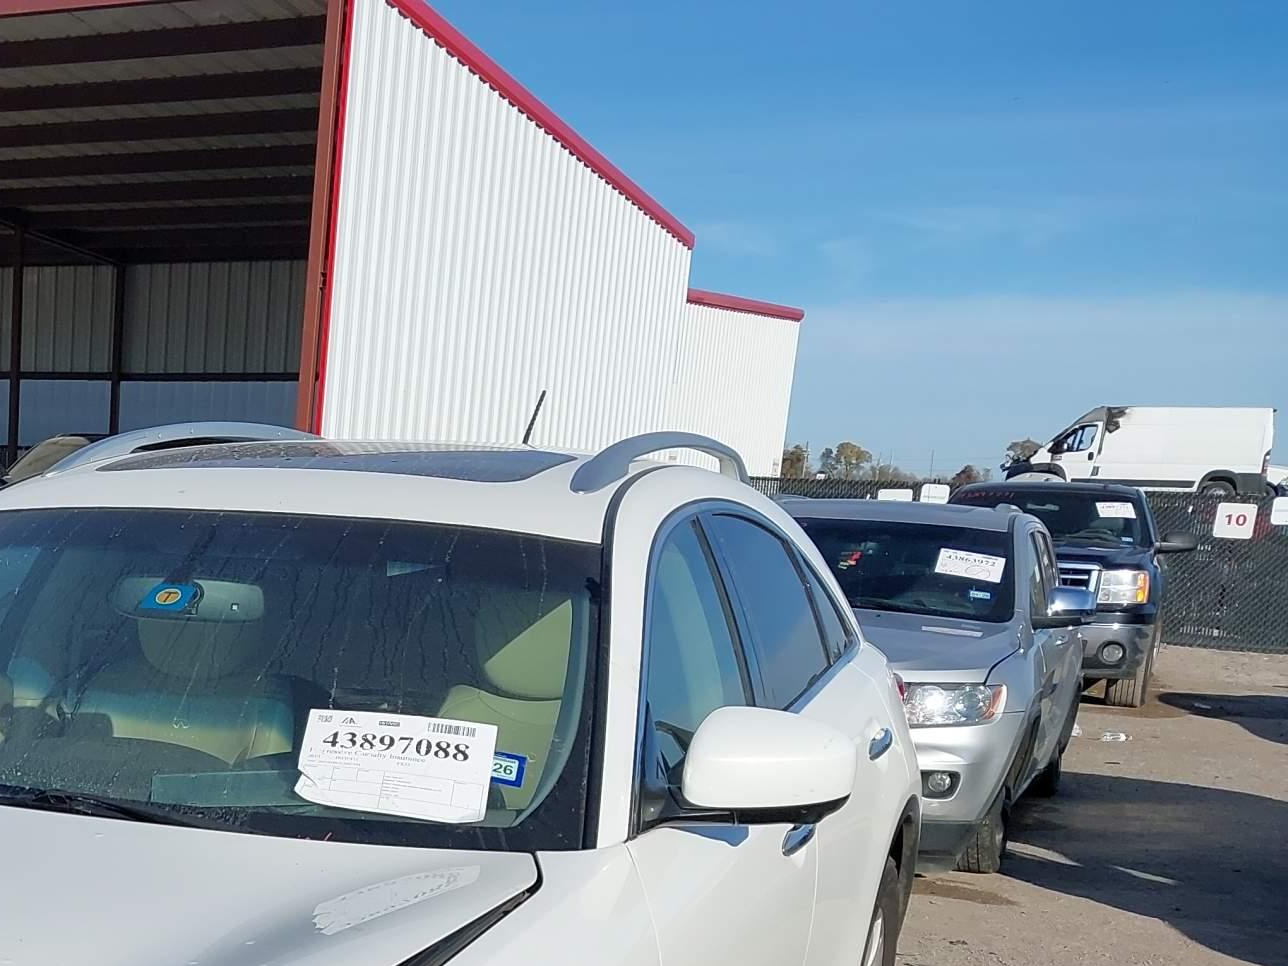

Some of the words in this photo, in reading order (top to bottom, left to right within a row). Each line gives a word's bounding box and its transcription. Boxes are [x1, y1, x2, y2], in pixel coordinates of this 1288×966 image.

[1224, 513, 1248, 527] 10
[322, 730, 470, 762] 43897088
[493, 762, 514, 776] 26
